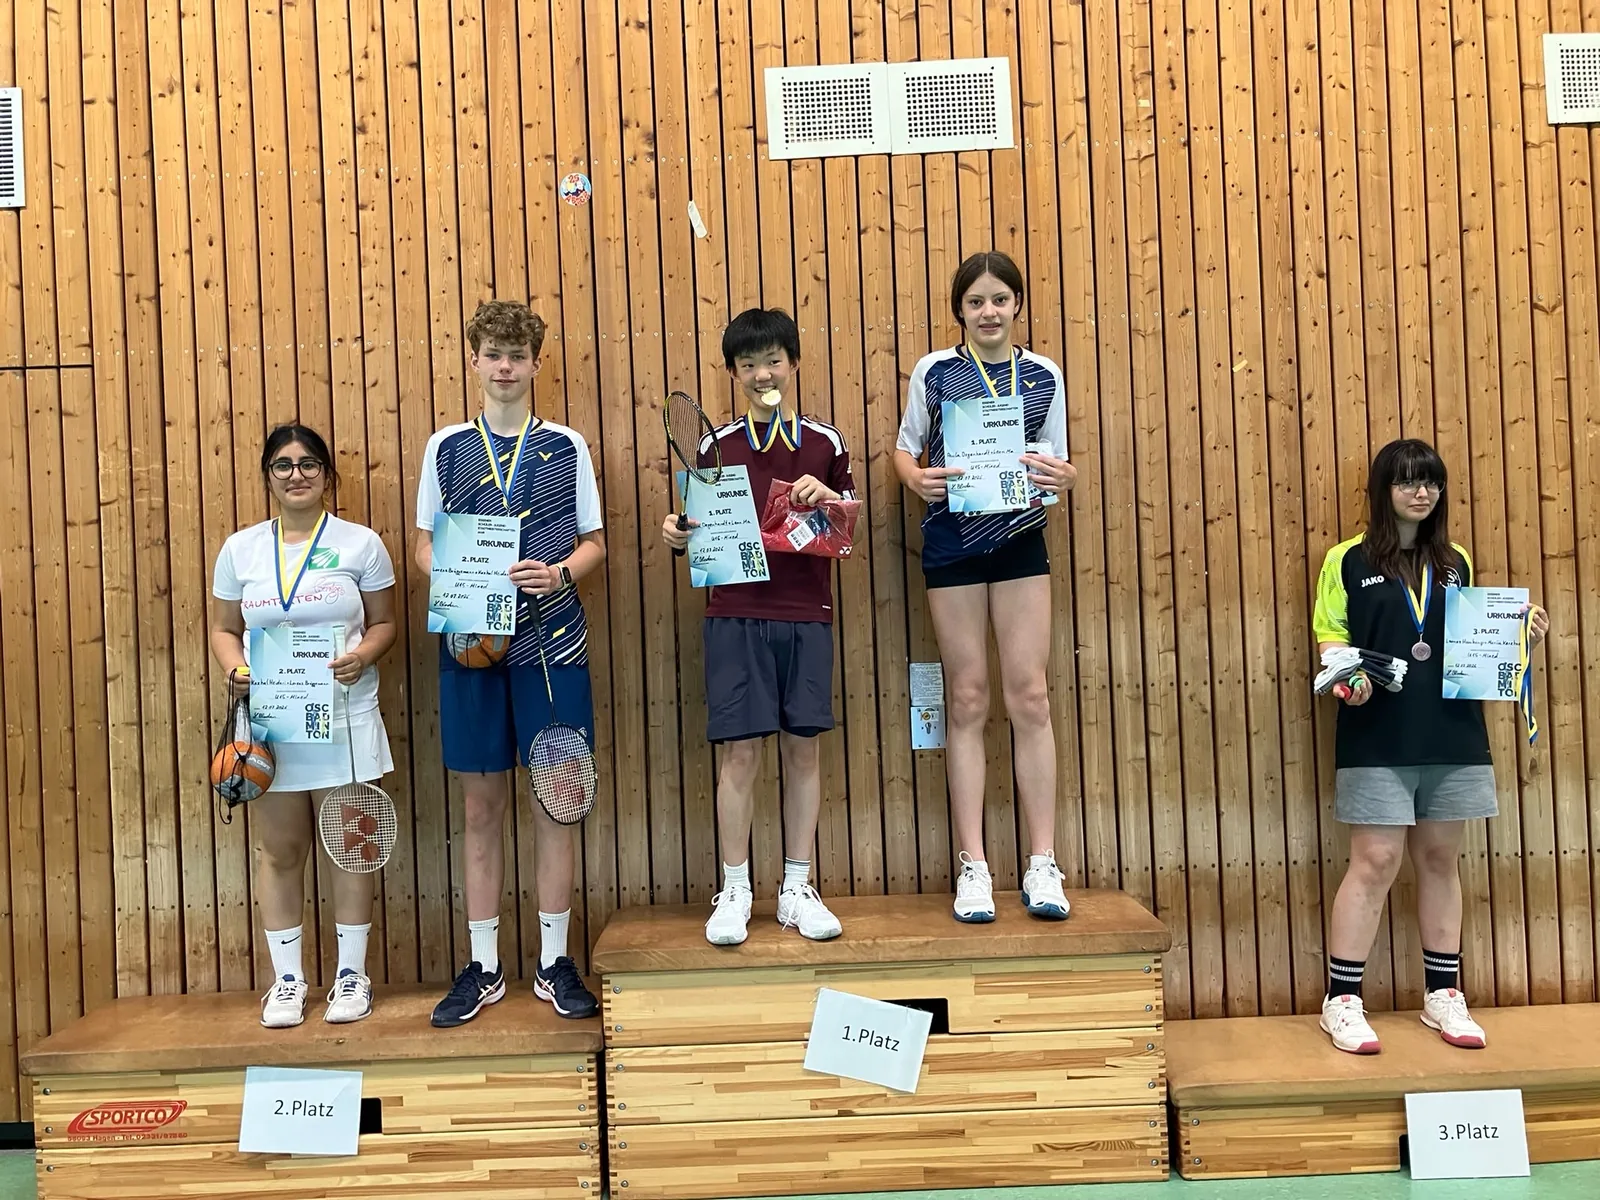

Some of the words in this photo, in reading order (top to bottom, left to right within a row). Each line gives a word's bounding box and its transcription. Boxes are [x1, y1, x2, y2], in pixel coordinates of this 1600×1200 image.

[983, 419, 1019, 428] URKUNDE
[1000, 480, 1024, 488] BAD
[717, 490, 748, 498] URKUNDE
[1002, 488, 1025, 497] MIN
[1003, 497, 1026, 505] TON
[477, 540, 515, 548] URKUNDE
[741, 551, 762, 560] BAD
[742, 559, 765, 569] MIN
[743, 568, 766, 578] TON
[1361, 576, 1384, 588] JAKO
[487, 603, 512, 612] BAD
[486, 612, 512, 622] MIN
[486, 622, 512, 631] TON
[306, 713, 330, 721] BAD
[306, 722, 330, 730] MIN
[306, 731, 329, 739] TON
[274, 1100, 334, 1117] 2.Platz
[85, 1109, 167, 1125] SPORTCO
[1439, 1123, 1499, 1140] 3.Platz
